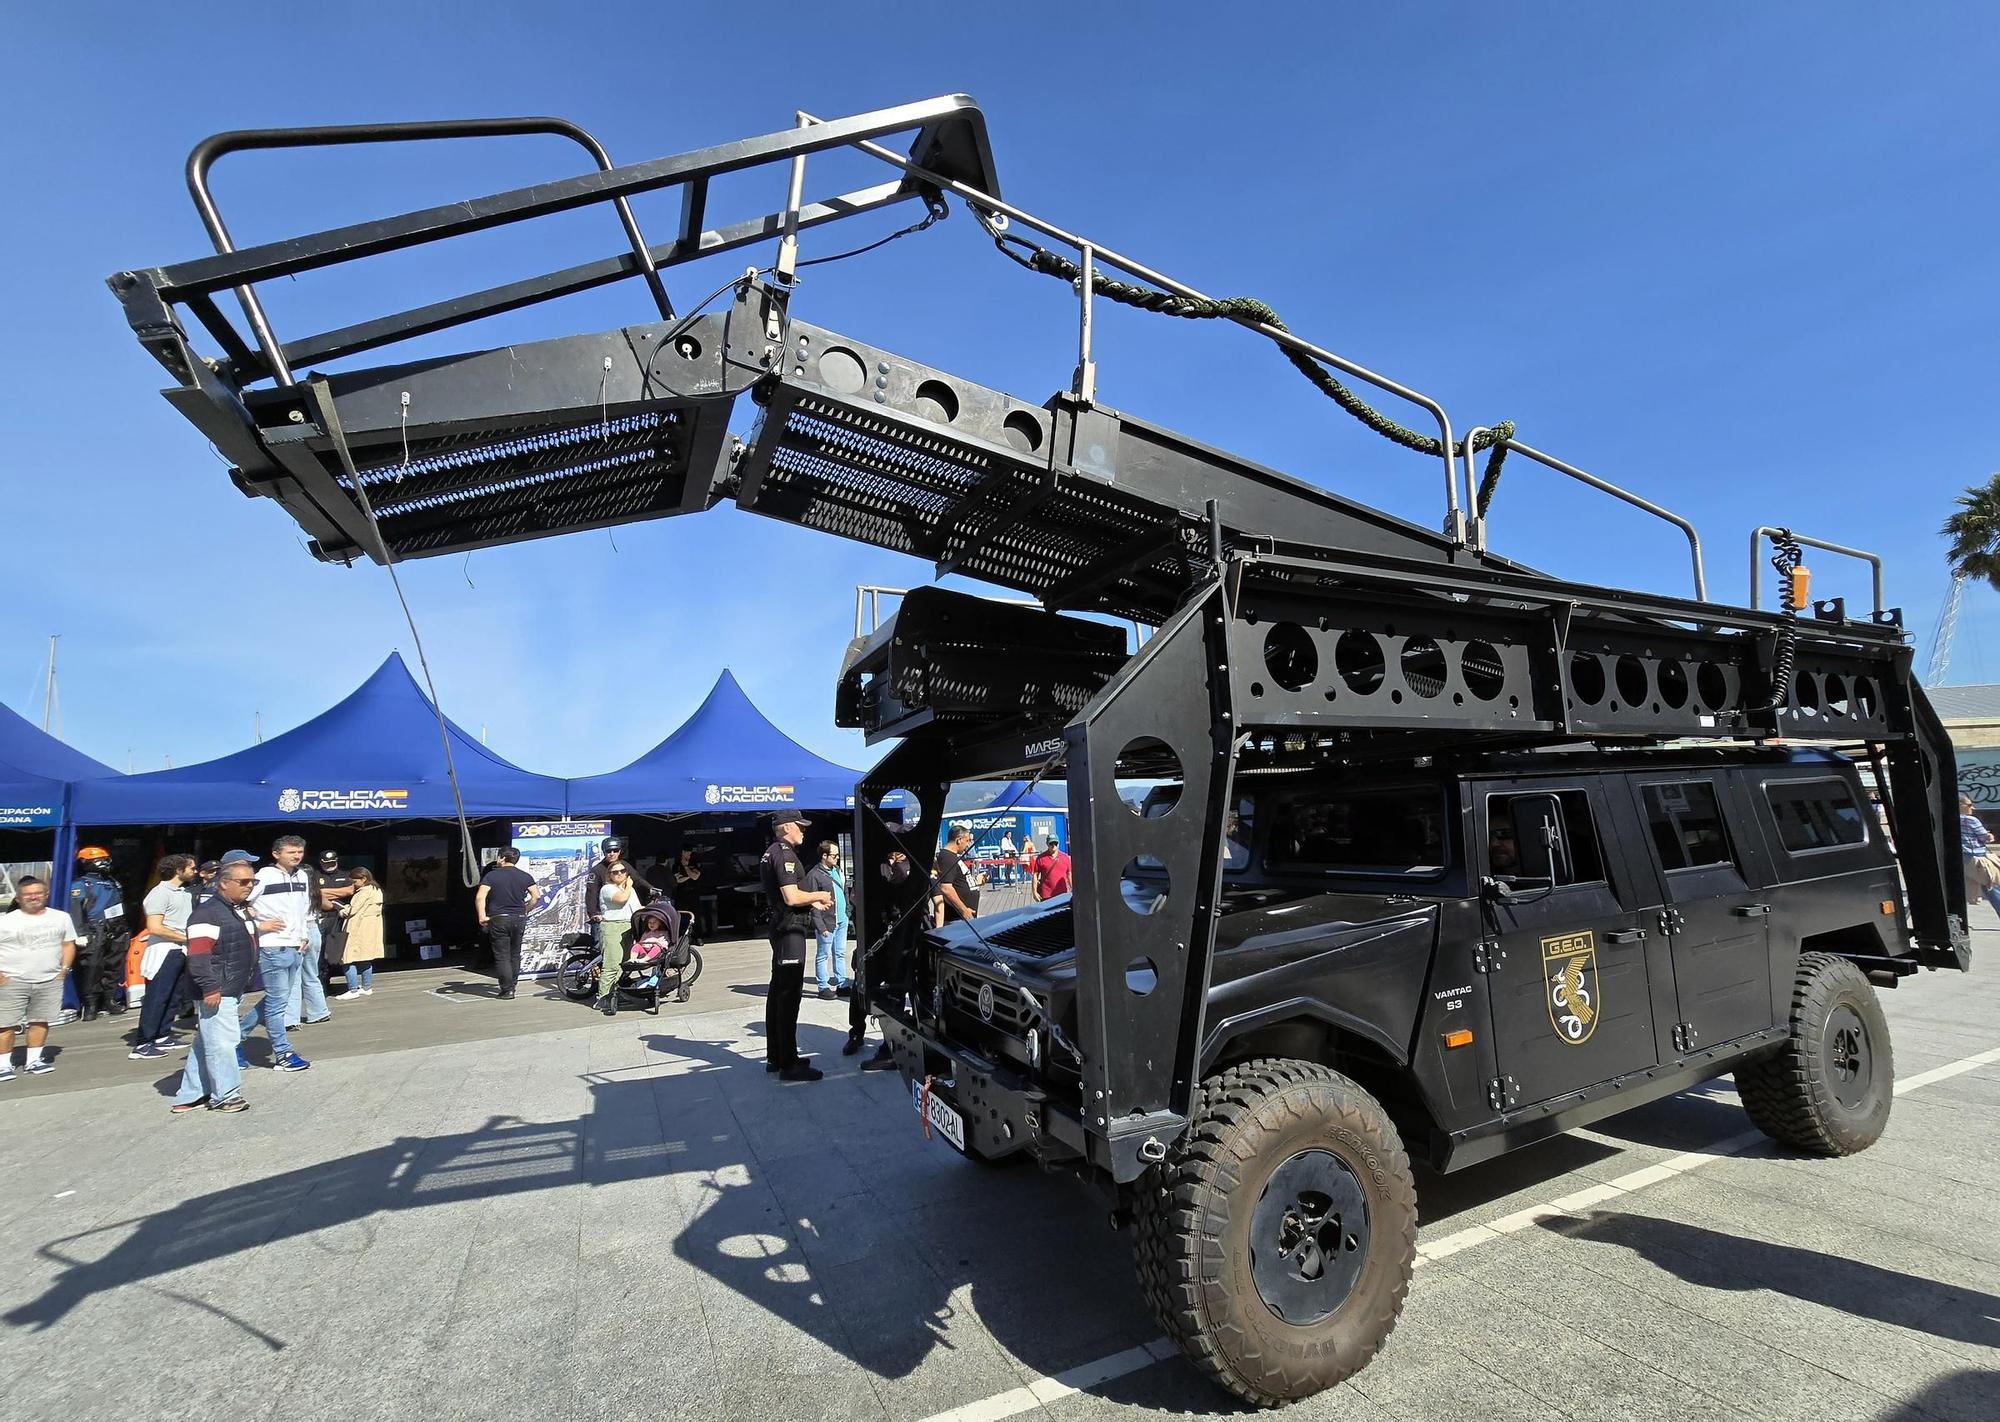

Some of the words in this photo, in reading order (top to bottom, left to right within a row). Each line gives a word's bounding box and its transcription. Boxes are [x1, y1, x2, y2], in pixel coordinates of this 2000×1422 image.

[1025, 737, 1060, 755] MARS
[302, 790, 386, 800] POLICIA
[721, 786, 779, 795] POLICIA
[721, 794, 795, 803] NACIONAL
[301, 799, 408, 810] NACIONAL
[550, 828, 605, 836] NACIONAL
[1550, 937, 1587, 955] G.E.O.
[1434, 985, 1473, 1000] VAMTAC
[1446, 999, 1463, 1011] S3
